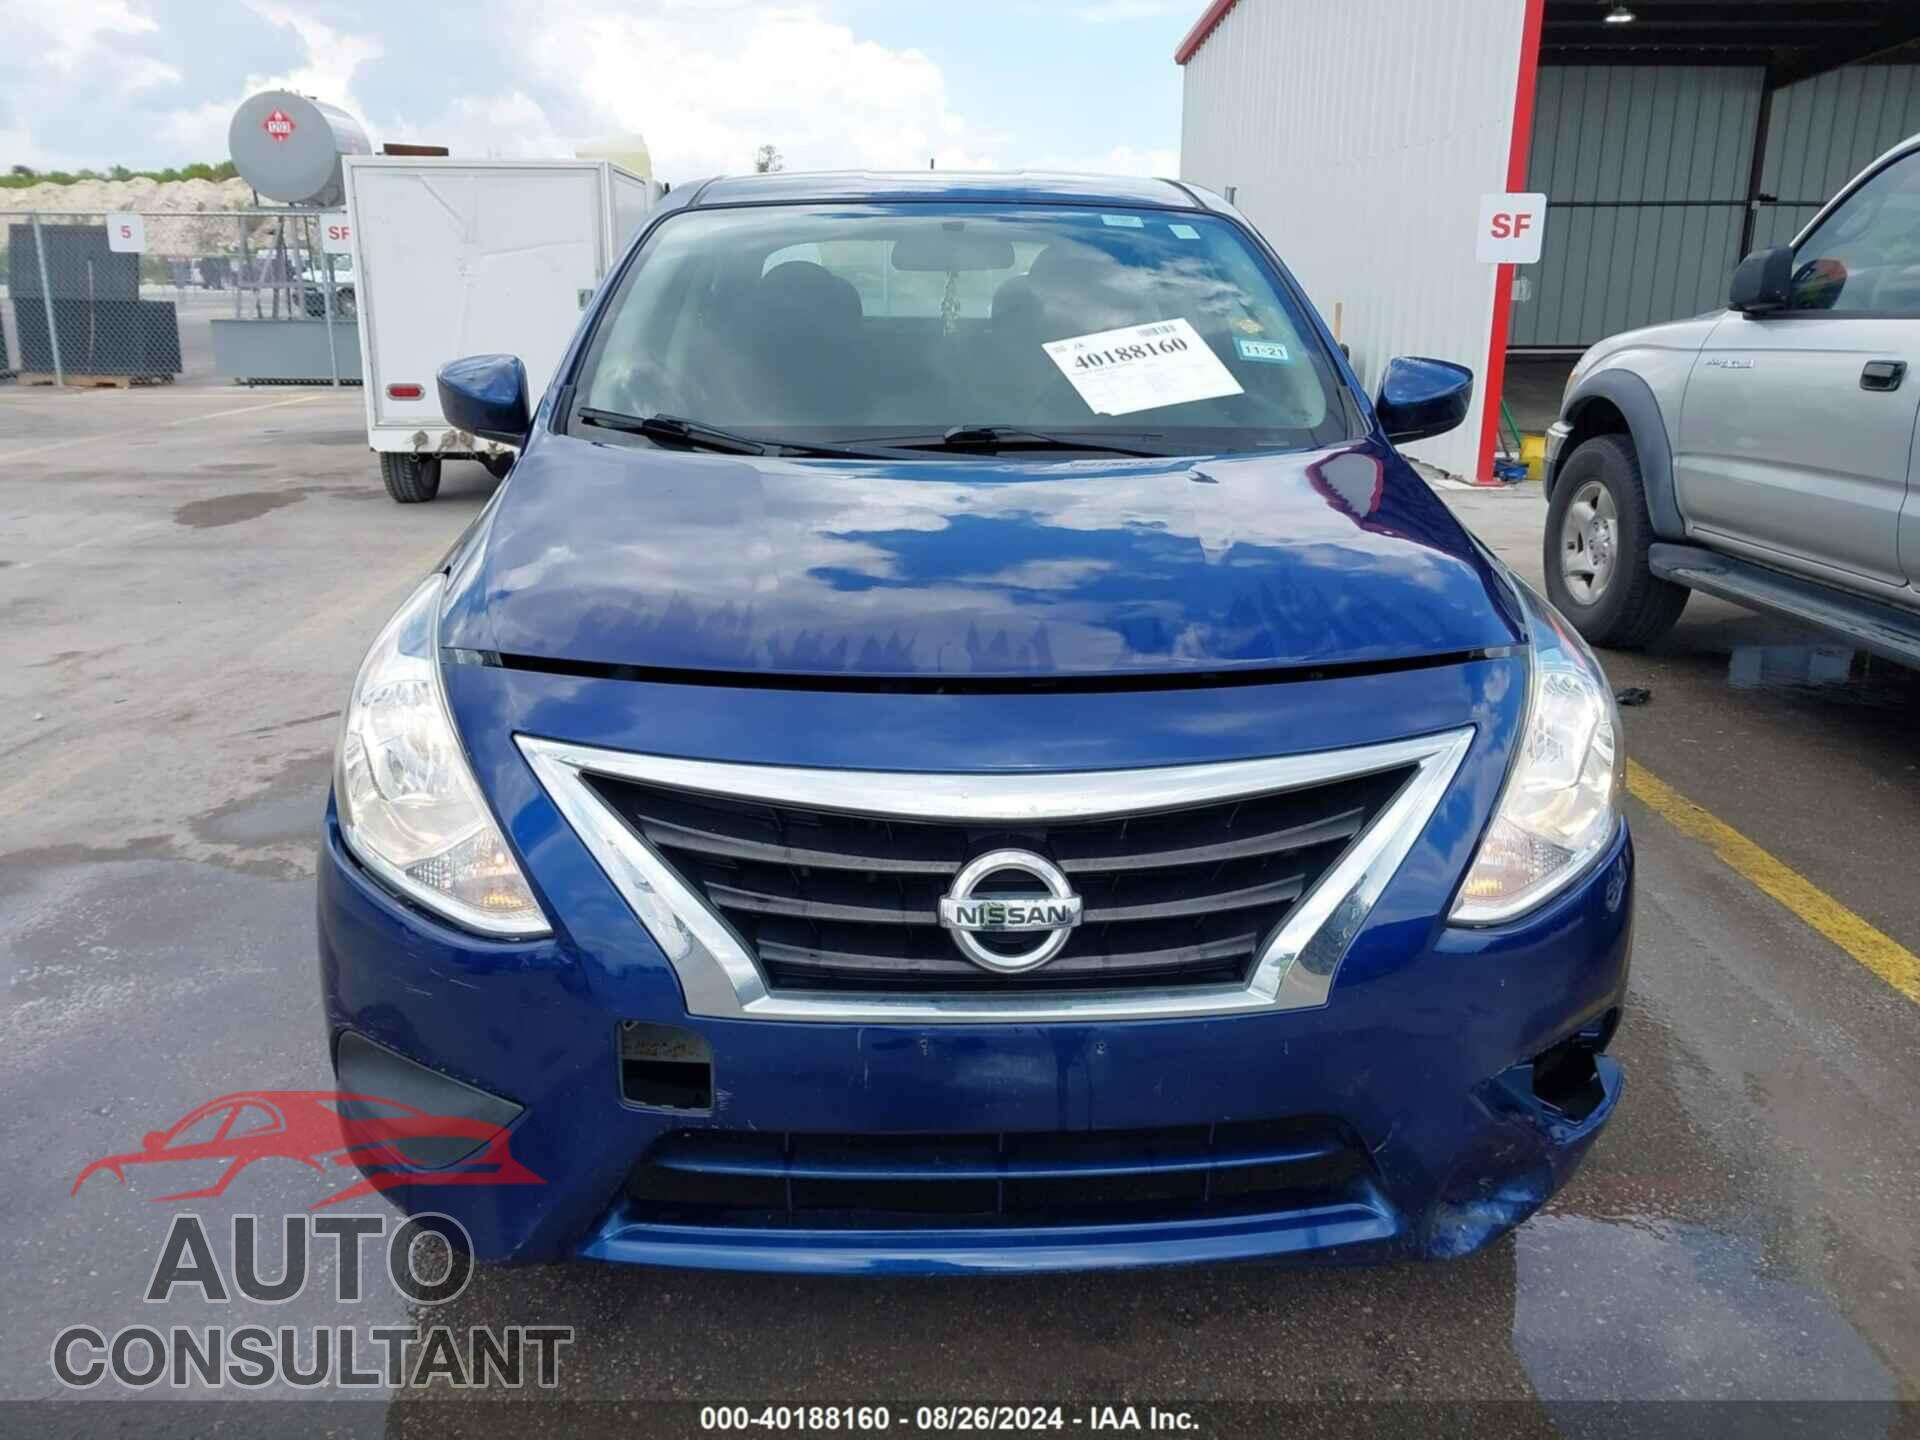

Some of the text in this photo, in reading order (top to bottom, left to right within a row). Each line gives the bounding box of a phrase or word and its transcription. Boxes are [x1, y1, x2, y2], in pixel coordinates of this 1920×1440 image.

[120, 224, 131, 239] 5
[327, 225, 350, 240] SF
[1491, 213, 1532, 239] SF
[1075, 337, 1188, 369] 40188160
[956, 905, 1067, 925] NISSAN
